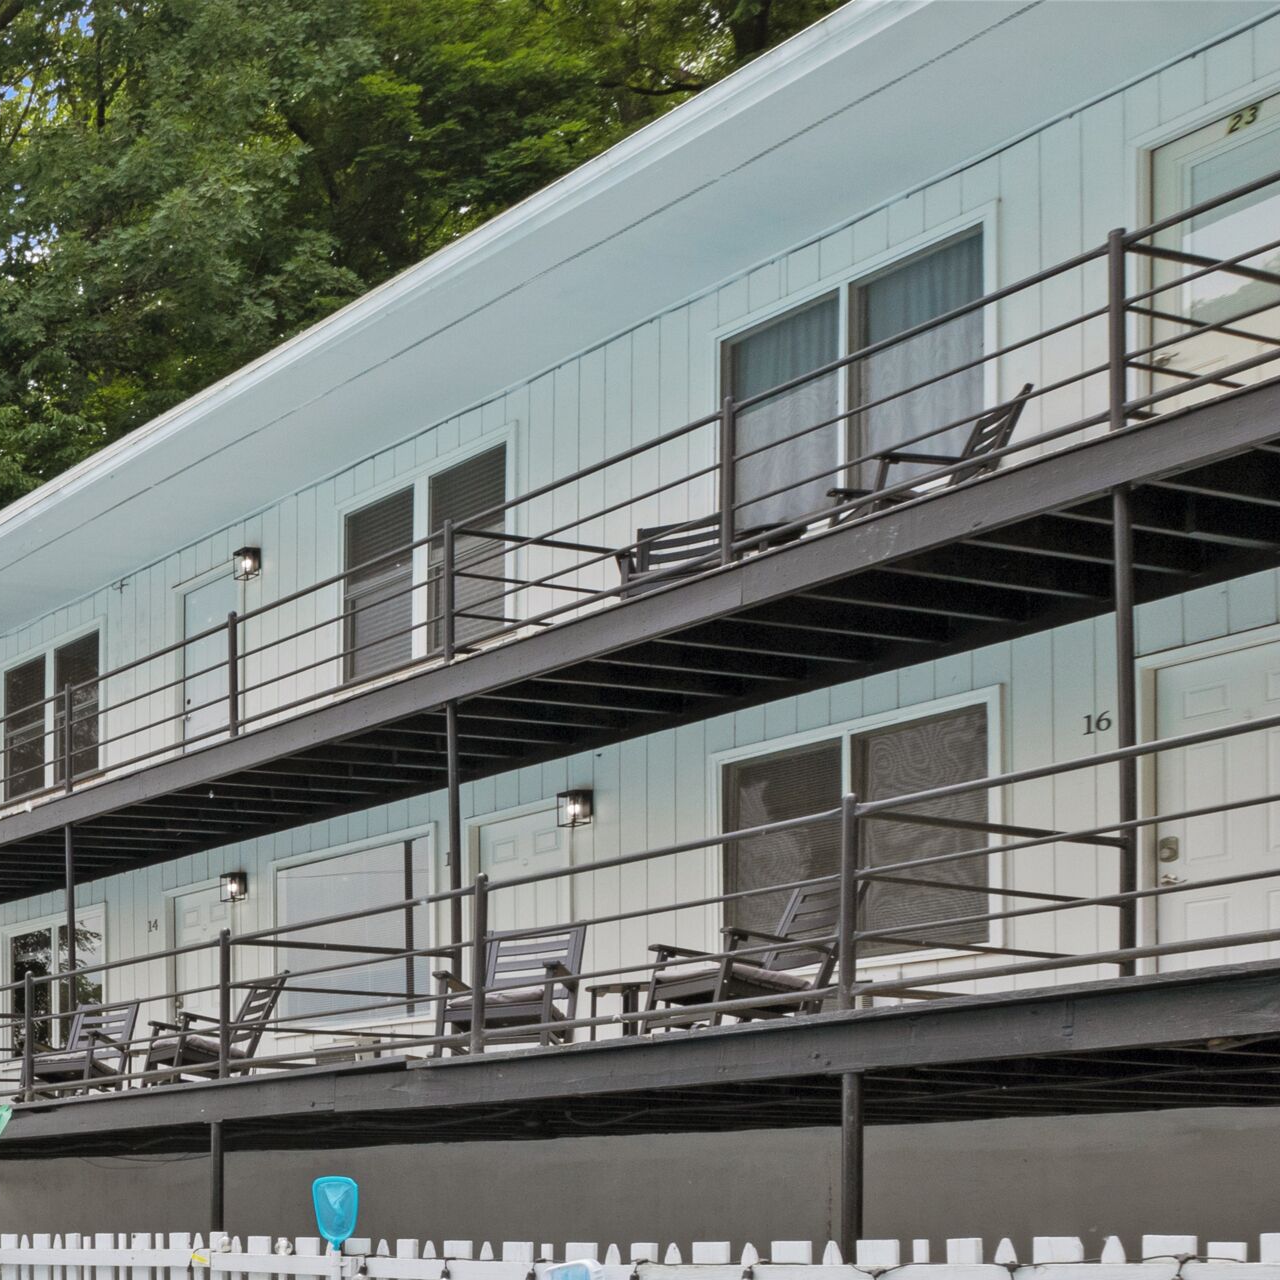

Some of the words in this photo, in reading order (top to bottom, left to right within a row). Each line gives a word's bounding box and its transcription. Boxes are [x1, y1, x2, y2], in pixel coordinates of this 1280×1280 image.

[1227, 106, 1259, 135] 23
[1082, 710, 1112, 735] 16
[147, 919, 158, 933] 14
